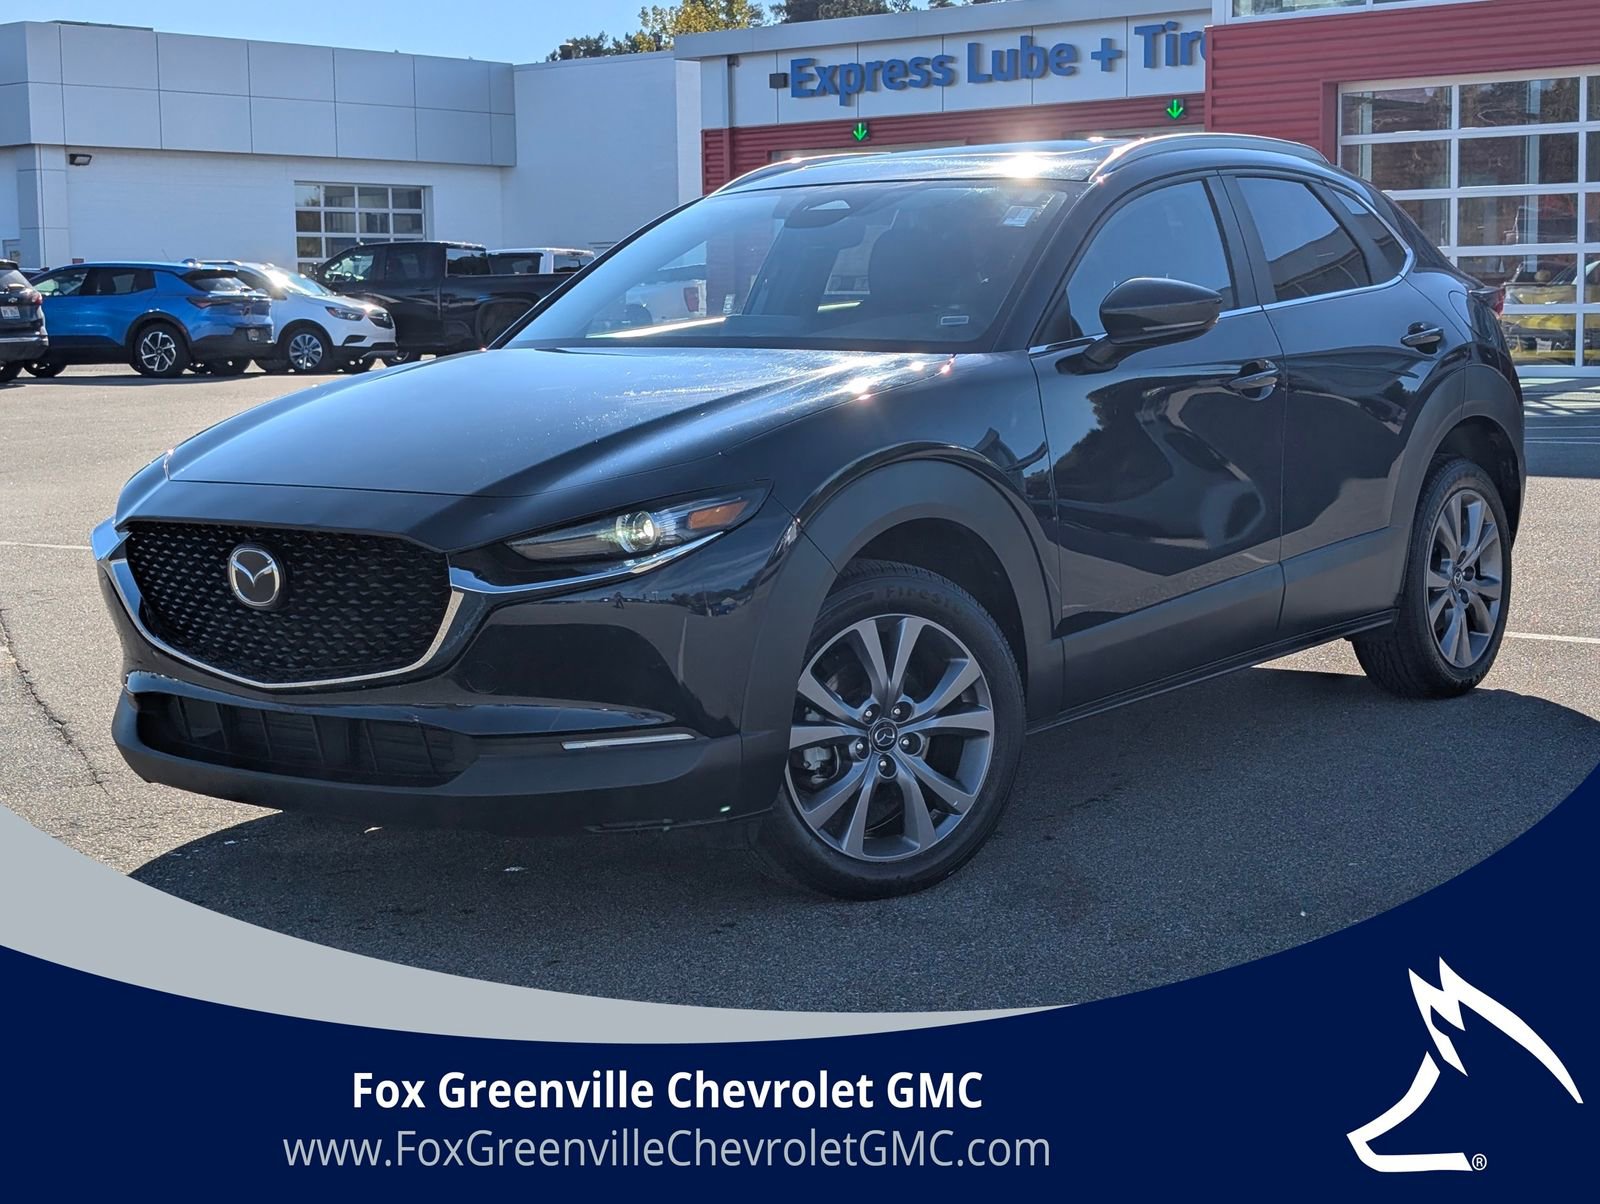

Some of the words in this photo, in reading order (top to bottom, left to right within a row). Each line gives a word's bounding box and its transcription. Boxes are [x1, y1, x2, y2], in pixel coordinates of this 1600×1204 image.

[790, 54, 956, 106] Express
[967, 35, 1077, 83] Lube
[1090, 38, 1123, 71] +
[1134, 21, 1206, 68] Tir
